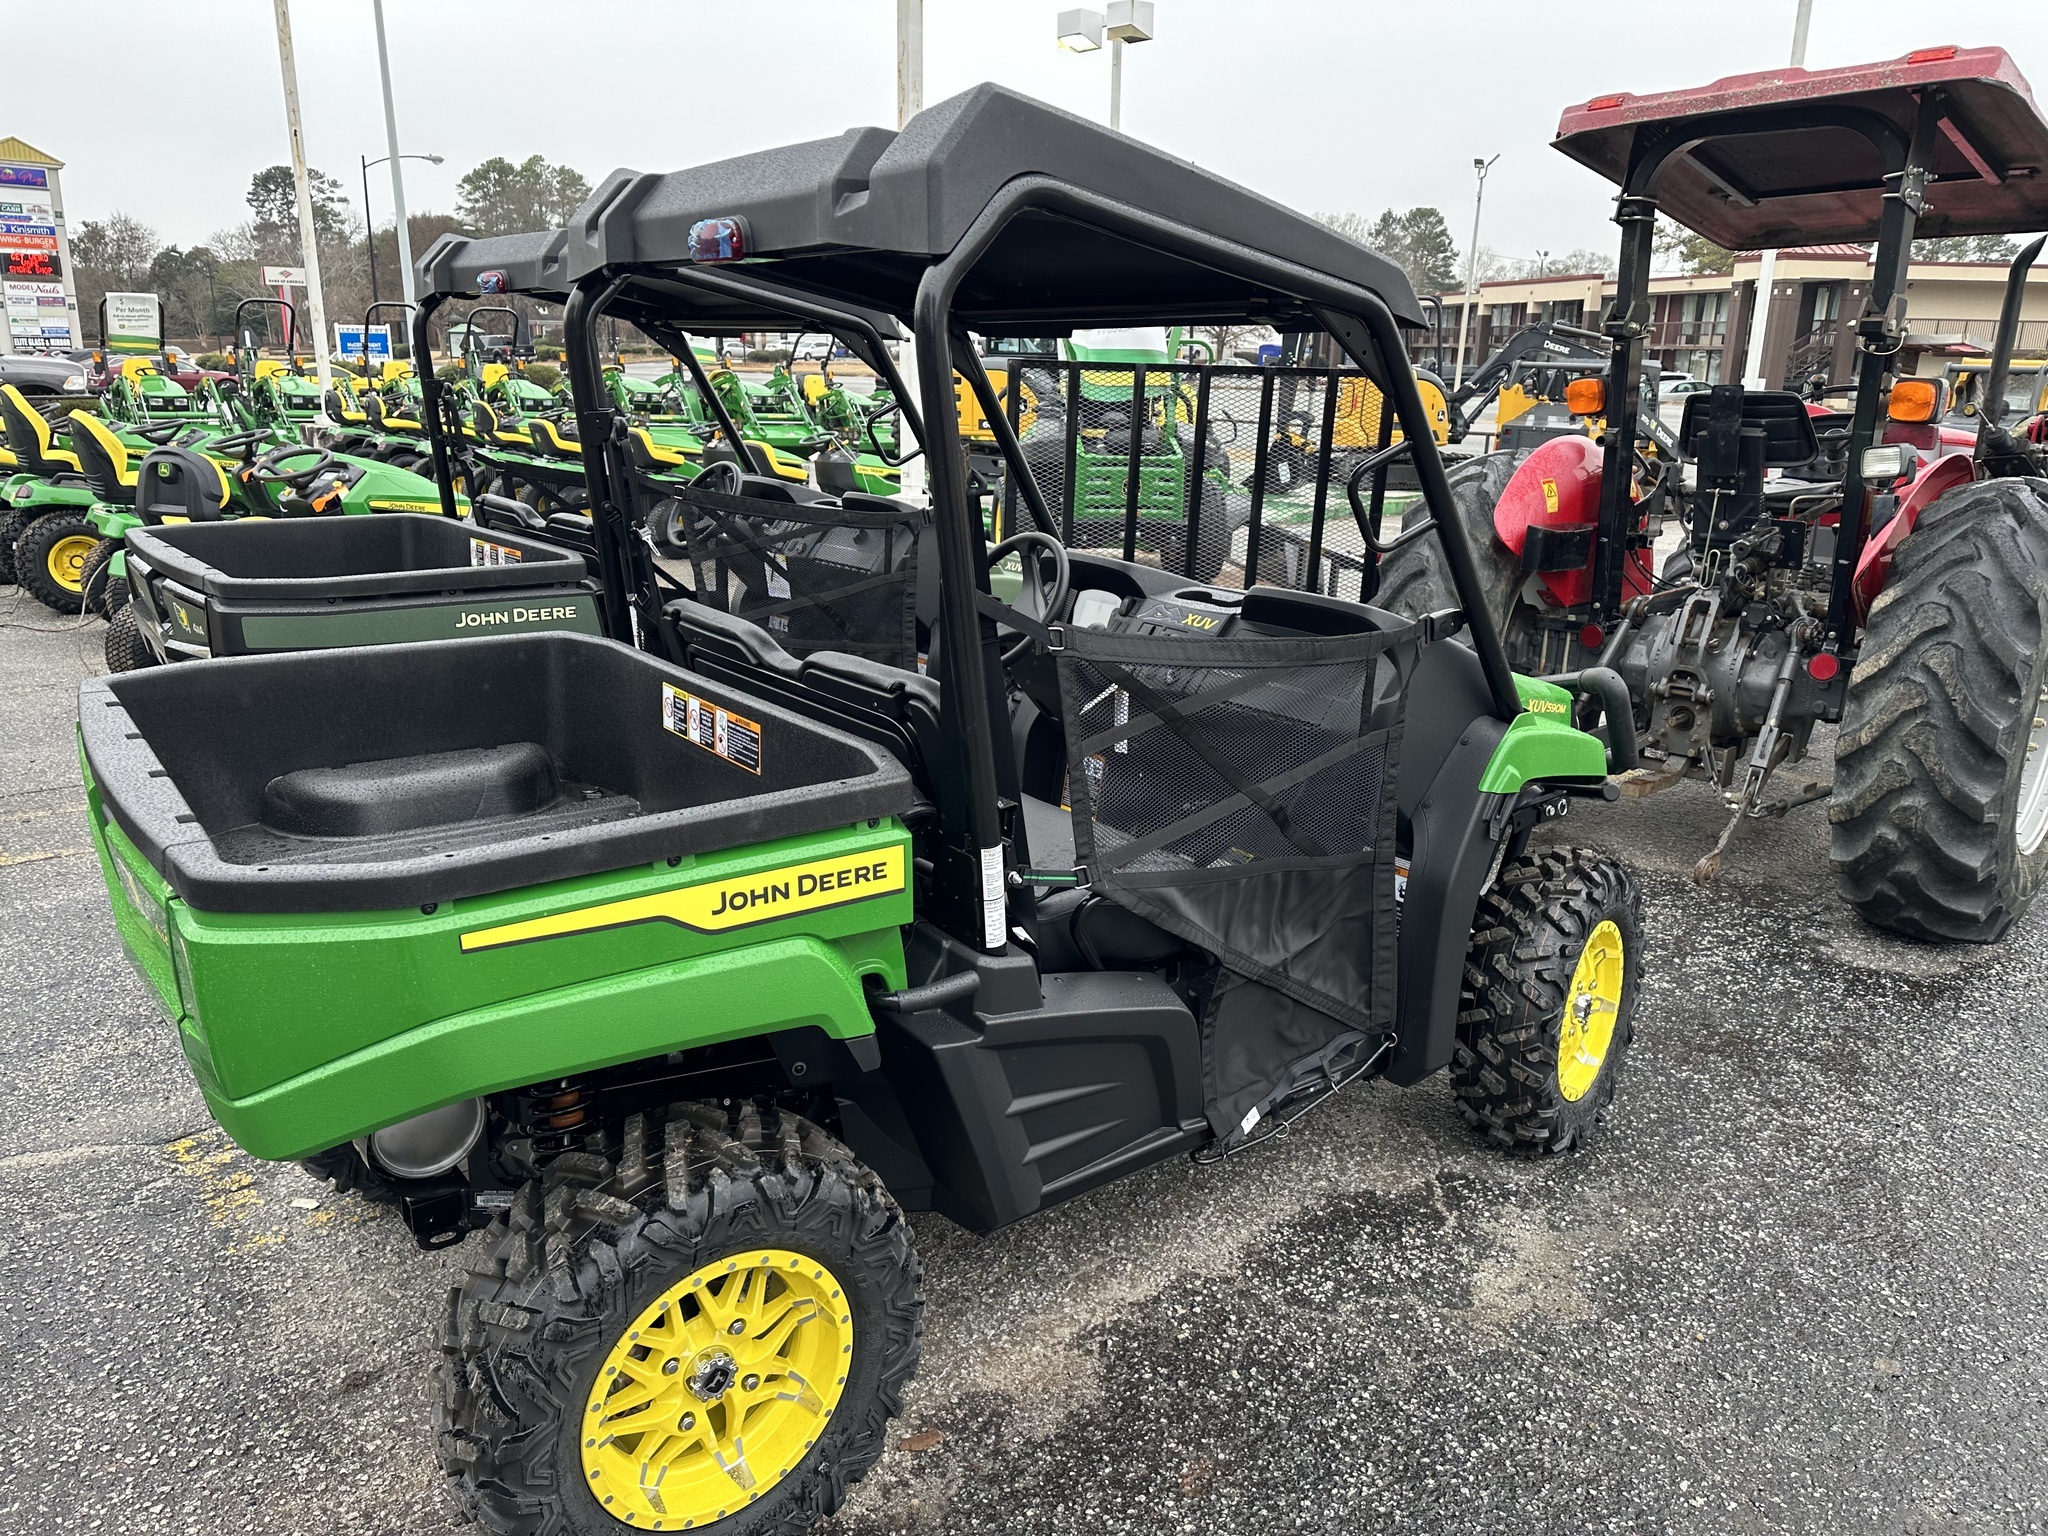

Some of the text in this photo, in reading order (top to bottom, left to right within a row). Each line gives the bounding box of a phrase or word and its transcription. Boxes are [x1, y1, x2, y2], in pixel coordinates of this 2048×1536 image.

[24, 237, 55, 246] BURGER
[10, 253, 25, 262] GET
[32, 284, 60, 294] Nails
[1543, 340, 1571, 354] DEERE
[1655, 426, 1674, 448] DEERE
[406, 503, 426, 511] DEERE
[455, 606, 577, 628] JOHN DEERE
[1182, 613, 1219, 630] XUV
[1528, 698, 1567, 714] XUV590M
[712, 861, 888, 916] JOHN DEERE
